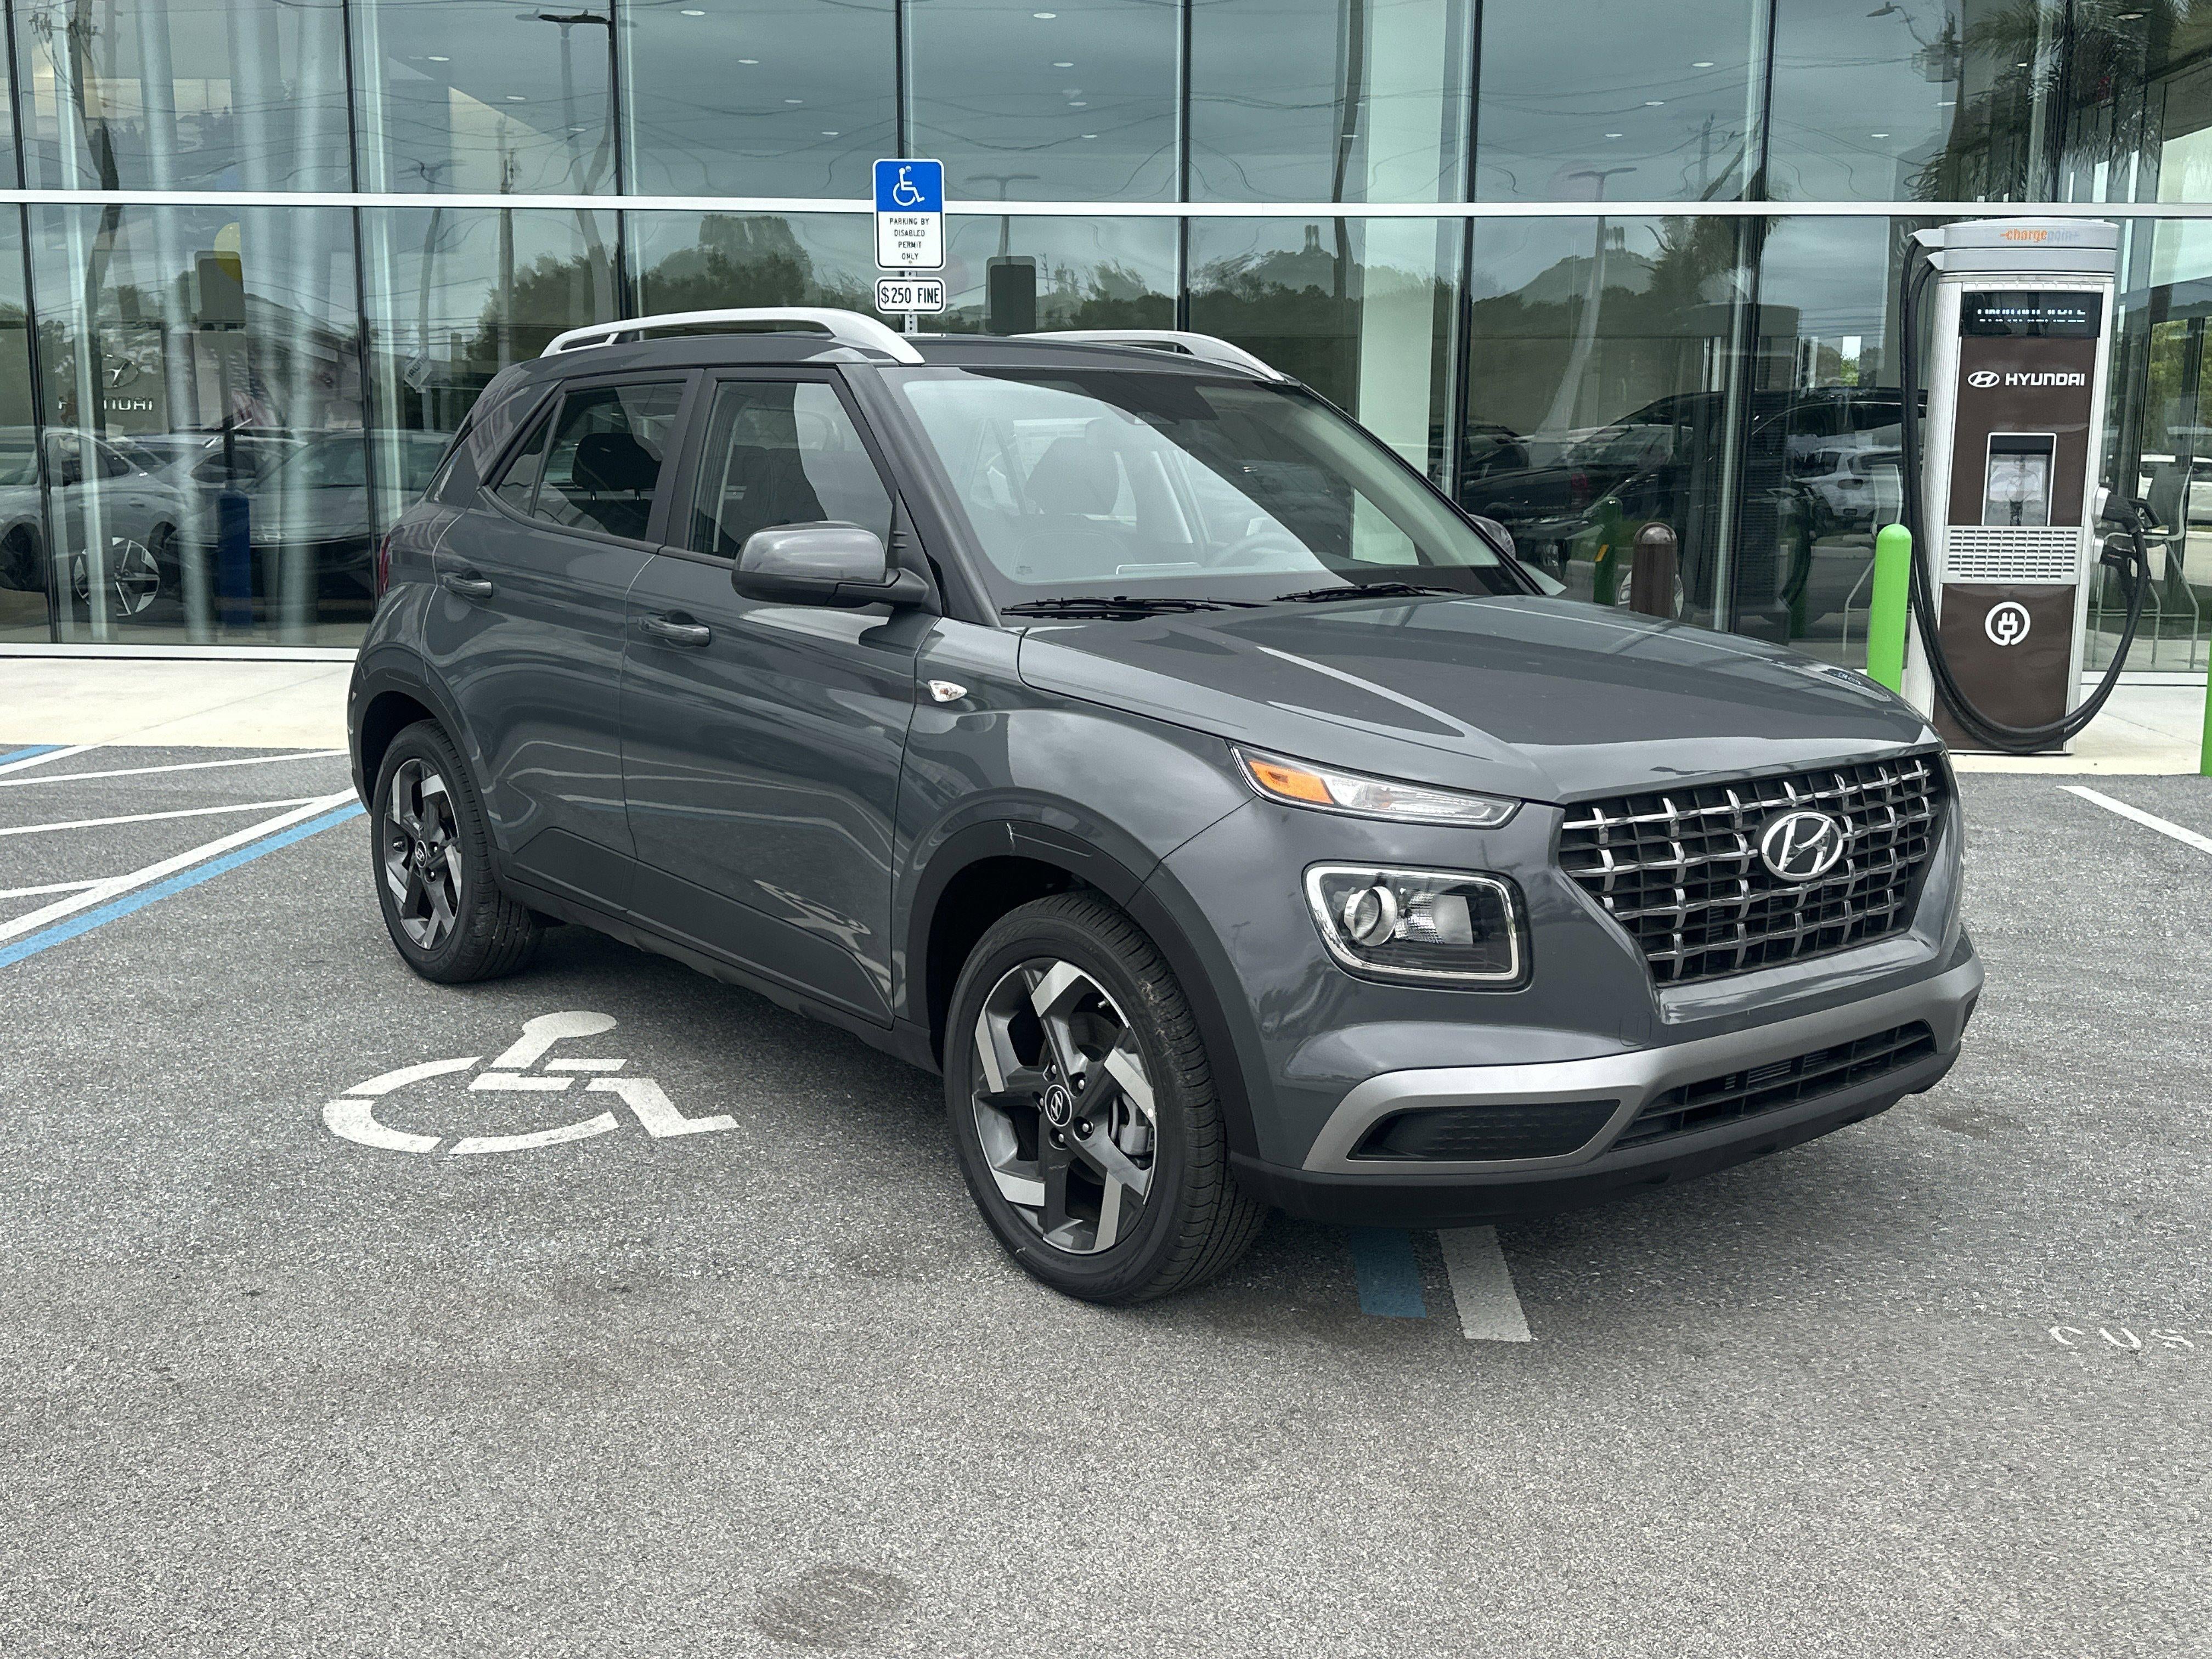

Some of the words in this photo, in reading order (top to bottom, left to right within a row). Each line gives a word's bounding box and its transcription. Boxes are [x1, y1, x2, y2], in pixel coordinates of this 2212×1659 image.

[881, 286, 911, 304] $250
[918, 287, 940, 303] FINE
[2005, 373, 2085, 386] HYUNDAI
[2049, 1325, 2212, 1349] CUS
